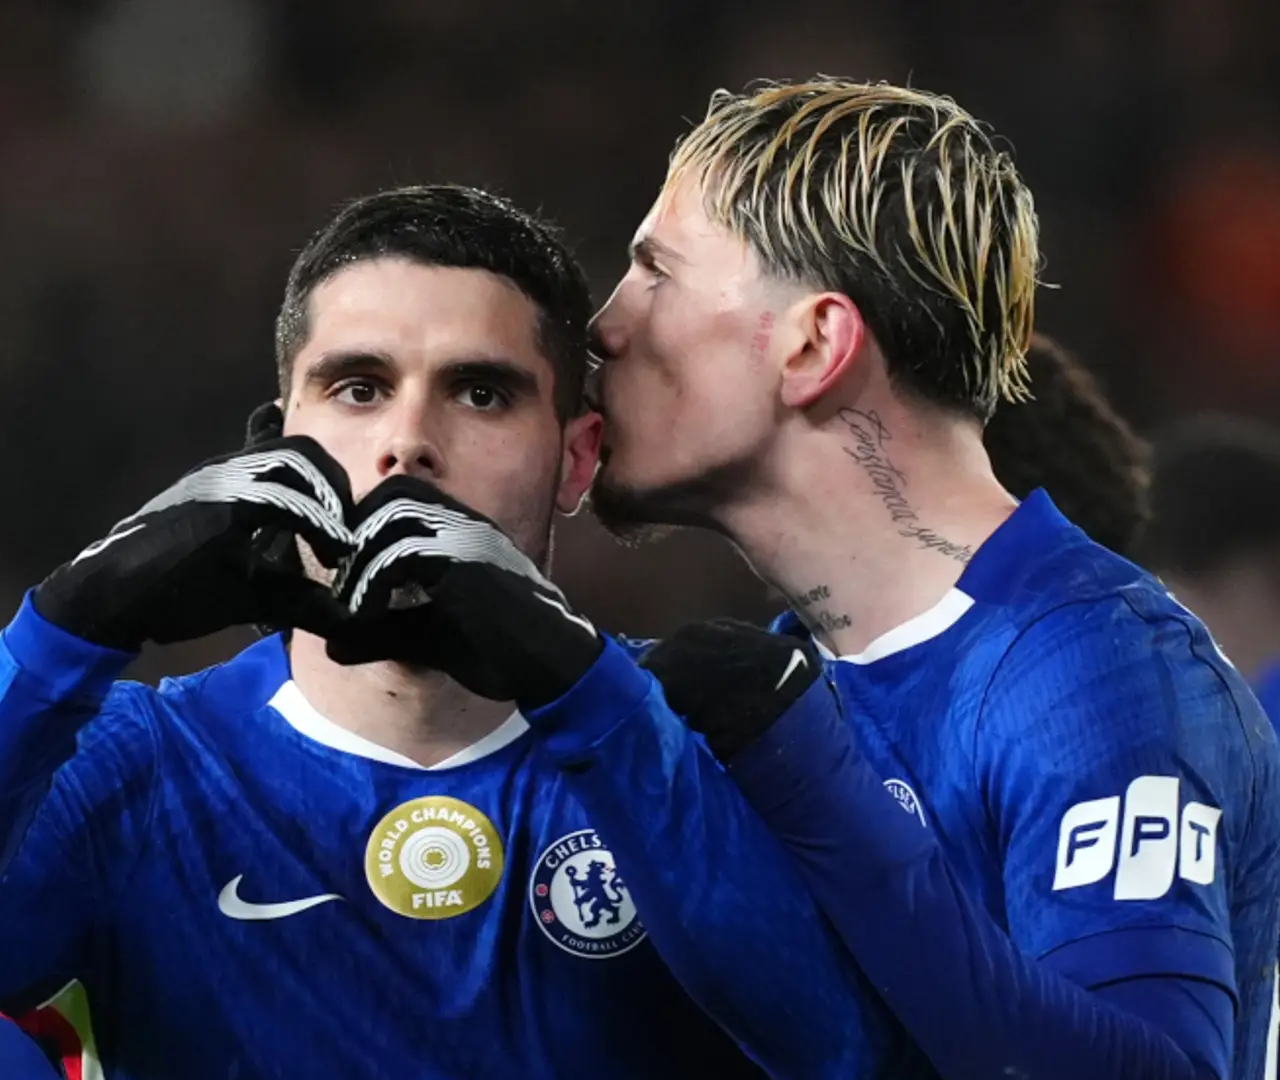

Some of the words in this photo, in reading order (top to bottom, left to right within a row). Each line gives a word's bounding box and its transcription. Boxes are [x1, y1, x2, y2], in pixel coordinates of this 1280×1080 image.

[378, 818, 410, 878] WORLD
[410, 806, 493, 870] CHAMPIONS
[544, 833, 608, 869] CHELS
[411, 889, 464, 910] FIFA
